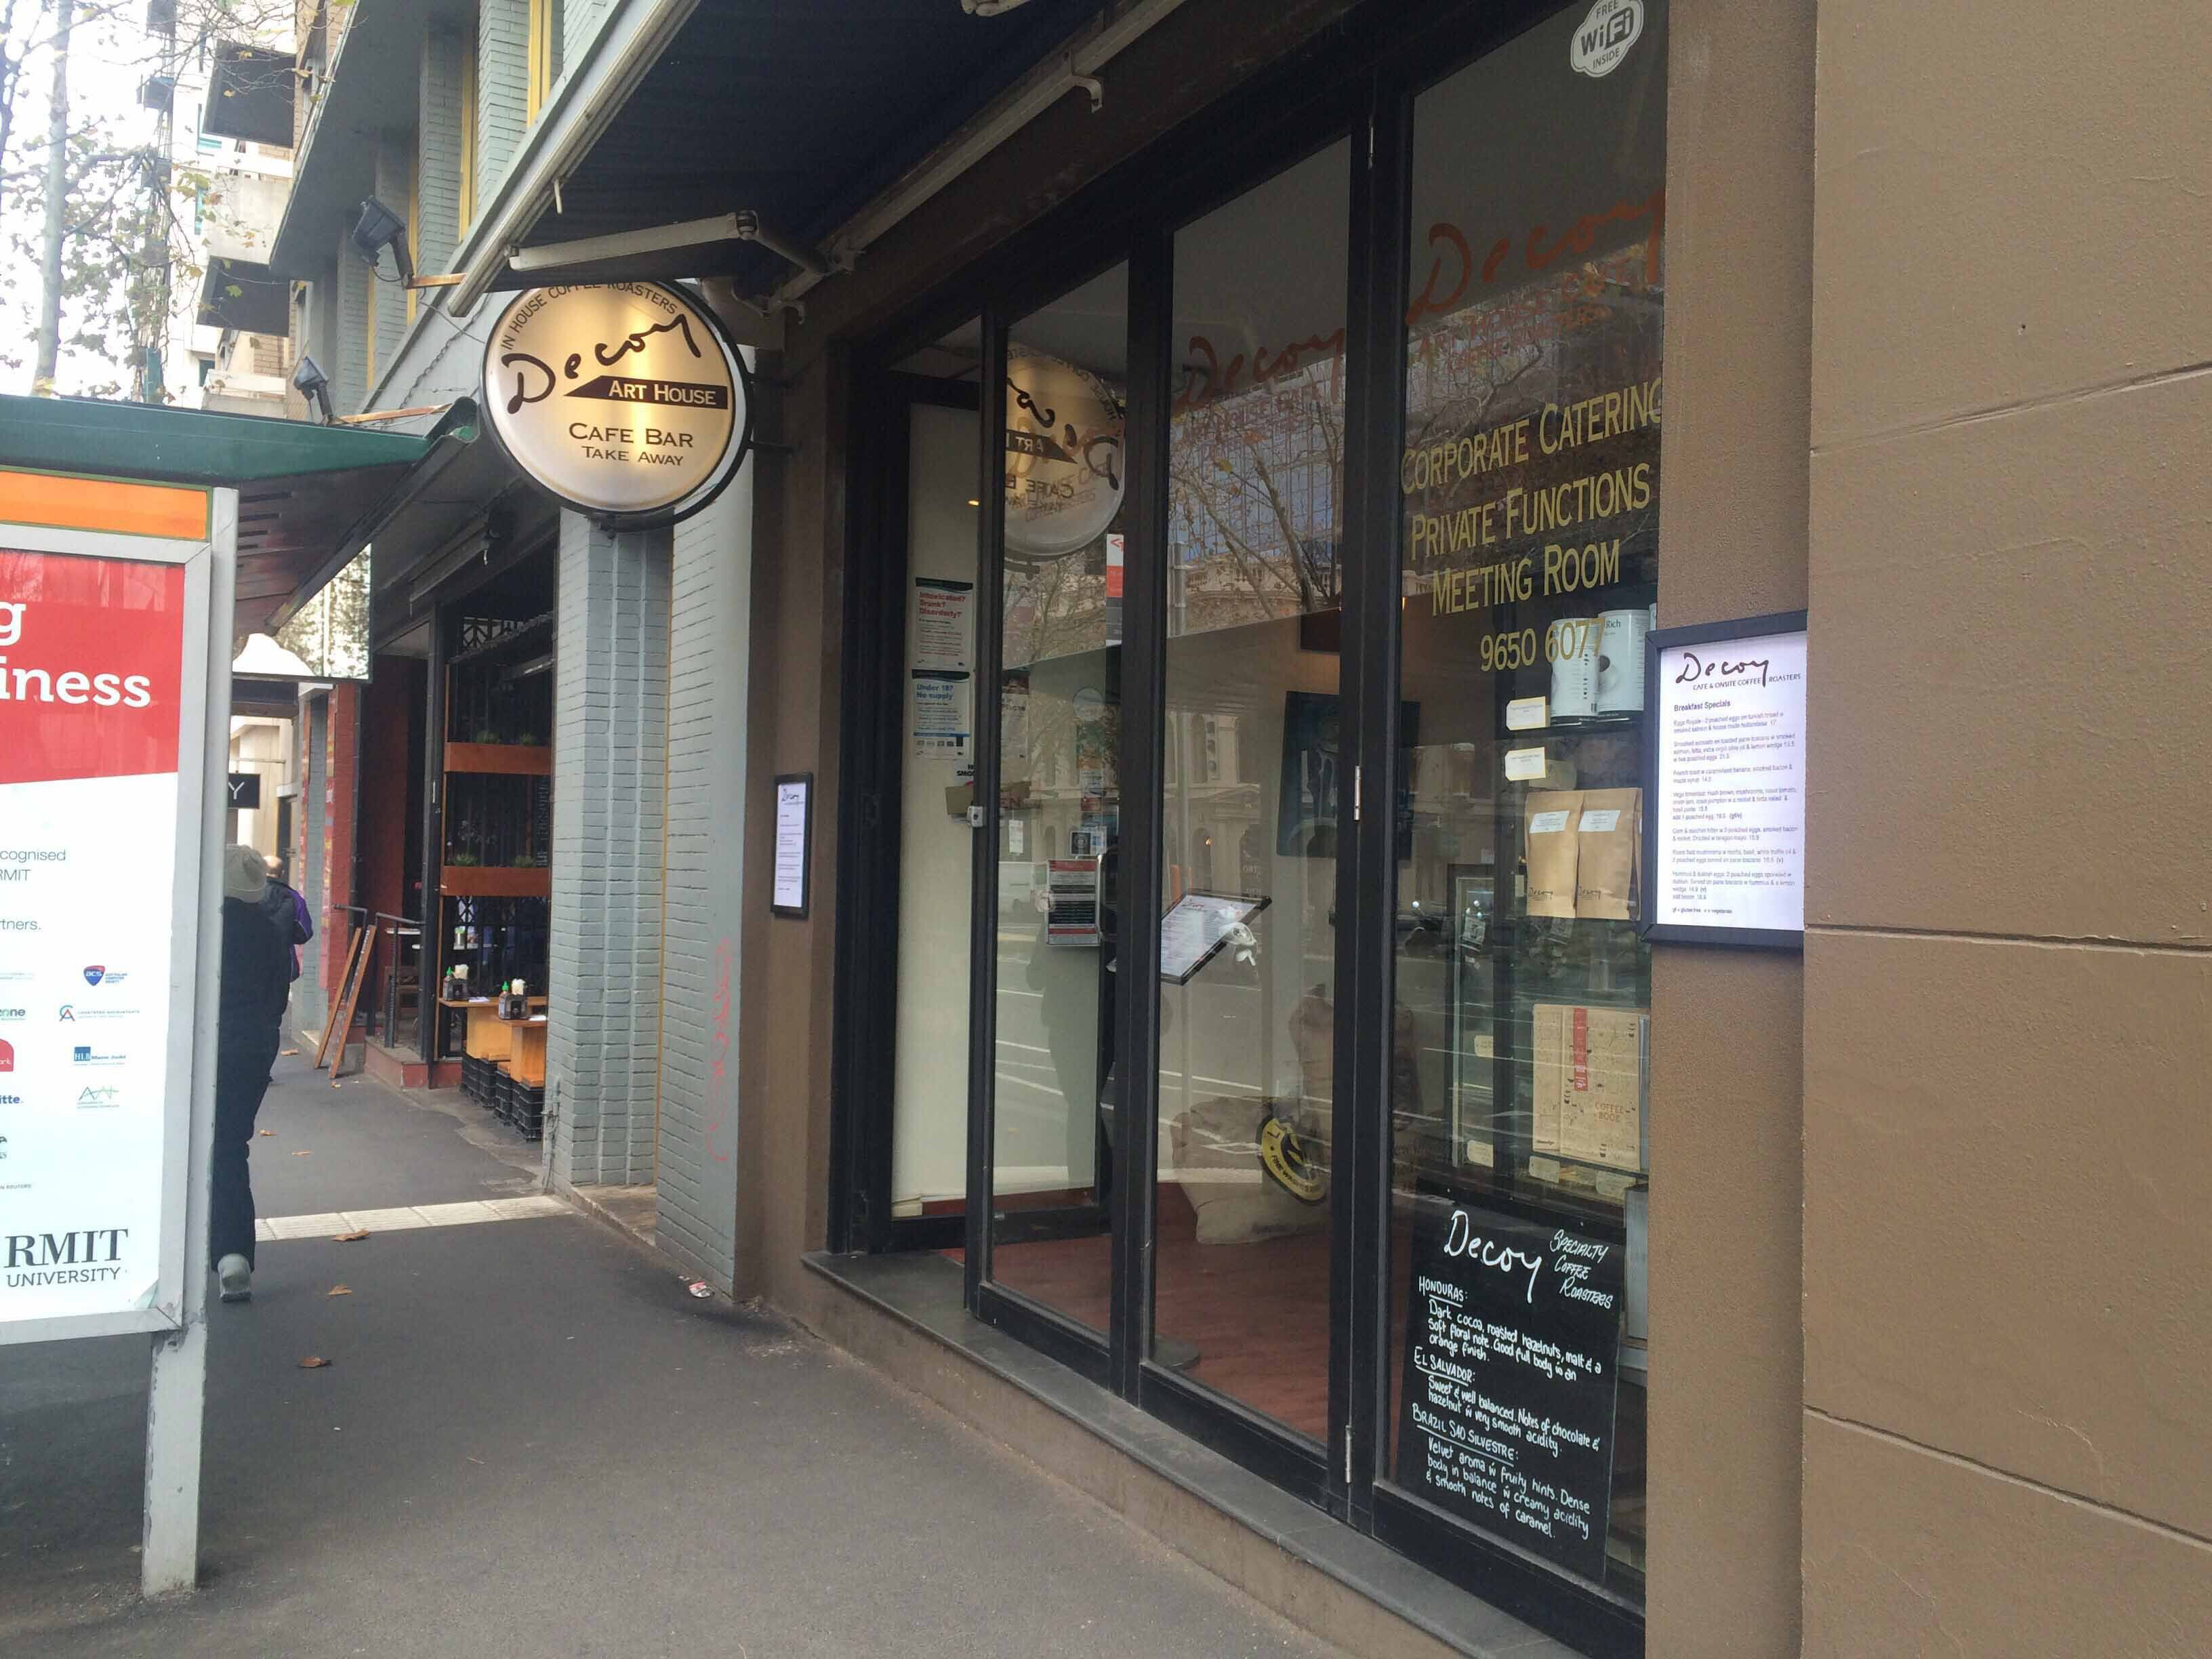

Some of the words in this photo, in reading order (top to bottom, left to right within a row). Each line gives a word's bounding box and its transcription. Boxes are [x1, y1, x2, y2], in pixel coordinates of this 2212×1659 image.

[1596, 1, 1619, 19] FREE
[1593, 47, 1620, 69] INSIDE
[501, 335, 516, 351] IN
[509, 295, 548, 333] HOUSE
[501, 314, 701, 415] Decoy
[609, 380, 647, 401] ART
[654, 384, 716, 406] HOUSE
[569, 422, 634, 445] CAFE
[645, 428, 694, 448] BAR
[581, 445, 630, 462] TAKE
[638, 451, 684, 466] AWAY
[1401, 419, 1530, 494] CORPORATE
[1411, 502, 1496, 561] PRIVATE
[1507, 462, 1651, 539] FUNCTIONS
[1432, 558, 1532, 617] MEETING
[1544, 539, 1620, 597] ROOM
[1480, 628, 1537, 673] 9650
[1545, 617, 1606, 663] 6077
[1676, 653, 1769, 687] Decoy
[1738, 678, 1761, 686] COFFEE
[1769, 674, 1801, 682] ROASTERS
[1674, 703, 1703, 712] Breakfast
[1704, 699, 1731, 710] Specials
[0, 849, 66, 863] cognised
[0, 918, 41, 930] tners.
[1595, 1102, 1624, 1114] COFFEE
[3, 1229, 129, 1269] RMIT
[1443, 1210, 1542, 1304] Decoy
[1550, 1229, 1609, 1263] SPECIALTY
[7, 1267, 121, 1288] UNIVERSITY
[1554, 1255, 1591, 1280] COFFEE
[1418, 1275, 1469, 1302] HONDURAS:
[1428, 1317, 1446, 1337] Soft
[1450, 1324, 1471, 1340] floral
[1493, 1338, 1514, 1357] Good
[1515, 1347, 1530, 1364] full
[1533, 1354, 1553, 1378] body
[1565, 1368, 1576, 1381] an
[1429, 1299, 1452, 1320] Dark
[1457, 1313, 1484, 1333] cocoa,
[1488, 1324, 1518, 1343] roasted
[1522, 1333, 1564, 1362] hazelnuts,
[1565, 1351, 1584, 1368] malt
[1595, 1361, 1601, 1374] a
[1429, 1333, 1458, 1356] orange
[1462, 1343, 1490, 1361] finish.
[1414, 1346, 1427, 1366] EL
[1430, 1354, 1475, 1383] SALVADOR:
[1428, 1374, 1453, 1395] Sweet
[1461, 1390, 1476, 1405] well
[1478, 1394, 1517, 1422] balanced.
[1518, 1408, 1540, 1429] Notes
[1540, 1418, 1550, 1437] of
[1552, 1422, 1591, 1448] chocolate
[1428, 1388, 1462, 1414] hazelnut
[1475, 1410, 1490, 1431] very
[1492, 1417, 1521, 1437] smooth
[1526, 1429, 1562, 1458] acidity.
[1412, 1402, 1447, 1433] BRAZIL
[1449, 1419, 1466, 1440] SAO
[1467, 1429, 1519, 1460] SILVESTRE:
[1428, 1436, 1454, 1458] Velvet
[1459, 1452, 1486, 1472] aroma
[1500, 1466, 1527, 1494] fruity
[1532, 1478, 1558, 1500] hints.
[1560, 1488, 1591, 1515] Dense
[1428, 1453, 1448, 1479] body
[1452, 1464, 1459, 1477] in
[1463, 1468, 1497, 1494] balance
[1513, 1492, 1549, 1520] creamy
[1553, 1508, 1589, 1540] acidity
[1435, 1475, 1467, 1497] smooth
[1472, 1490, 1494, 1509] notes
[1499, 1502, 1510, 1519] of
[1515, 1509, 1556, 1539] caramel.
